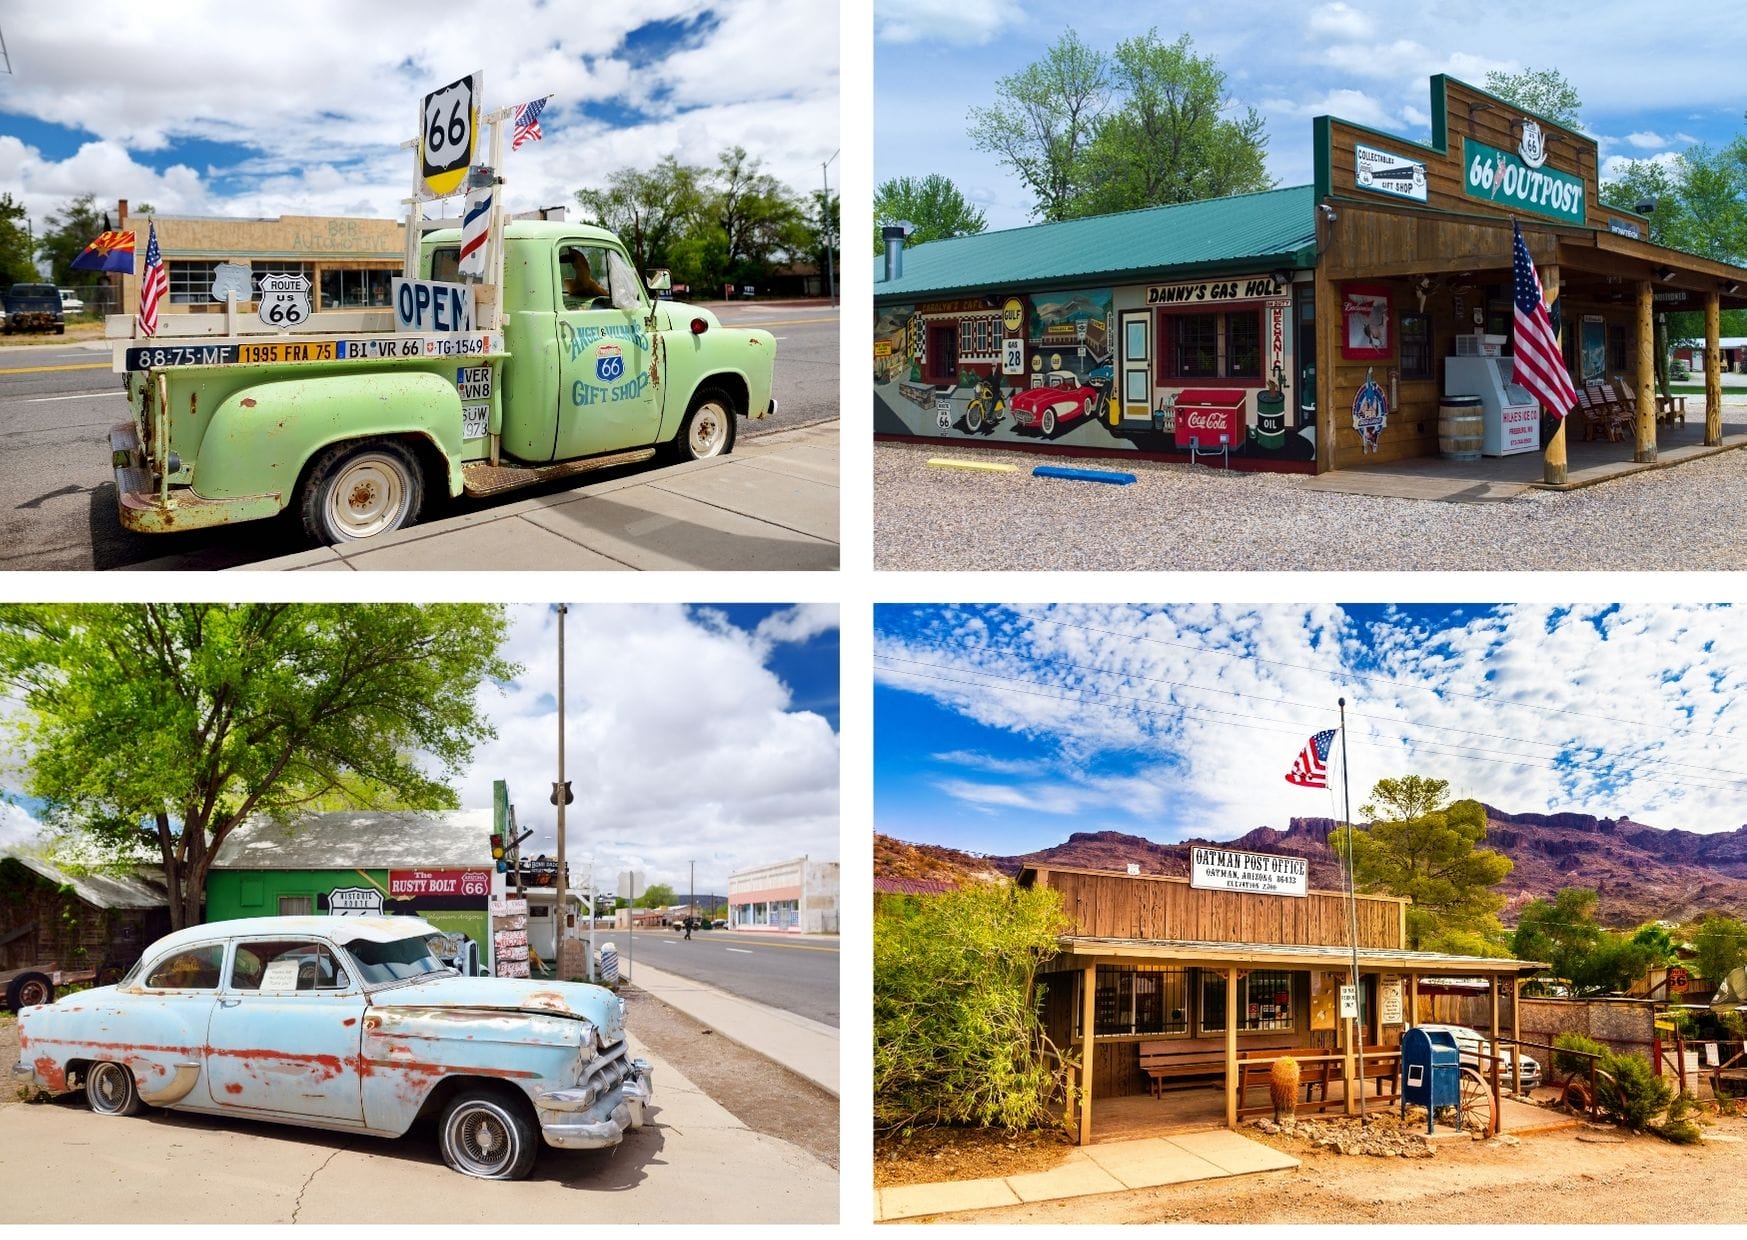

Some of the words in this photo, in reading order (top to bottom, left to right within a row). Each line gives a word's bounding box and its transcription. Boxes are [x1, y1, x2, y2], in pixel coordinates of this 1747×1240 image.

[429, 99, 465, 152] 66
[1527, 140, 1537, 153] 66
[1396, 183, 1413, 194] SHOP
[1470, 155, 1494, 189] 66
[1503, 164, 1583, 214] OUTPOST
[293, 235, 388, 249] AUTOMOTIVE
[271, 281, 301, 290] ROUTE
[1149, 284, 1207, 303] DANNY'S
[1211, 282, 1238, 299] GAS
[1245, 279, 1283, 297] HOLE
[269, 304, 300, 322] 66
[398, 282, 469, 332] OPEN
[1004, 309, 1021, 321] GULF
[379, 342, 396, 356] VR
[402, 340, 419, 355] 66
[572, 326, 600, 361] ANGEL
[245, 347, 277, 362] 1995
[285, 345, 308, 360] FRA
[316, 344, 331, 359] 75
[602, 359, 620, 376] 66
[465, 369, 489, 382] VER
[572, 380, 608, 406] GIFT
[612, 371, 650, 401] SHOP
[939, 416, 949, 427] 66
[1263, 419, 1277, 429] OIL
[1196, 849, 1241, 869] OATMAN
[1244, 855, 1270, 872] POST
[1271, 858, 1305, 876] OFFICE
[1241, 872, 1273, 882] ARIZONA
[392, 880, 427, 893] RUSTY
[429, 880, 457, 892] BOLT
[465, 883, 484, 895] 66
[340, 892, 373, 900] HISTORIC
